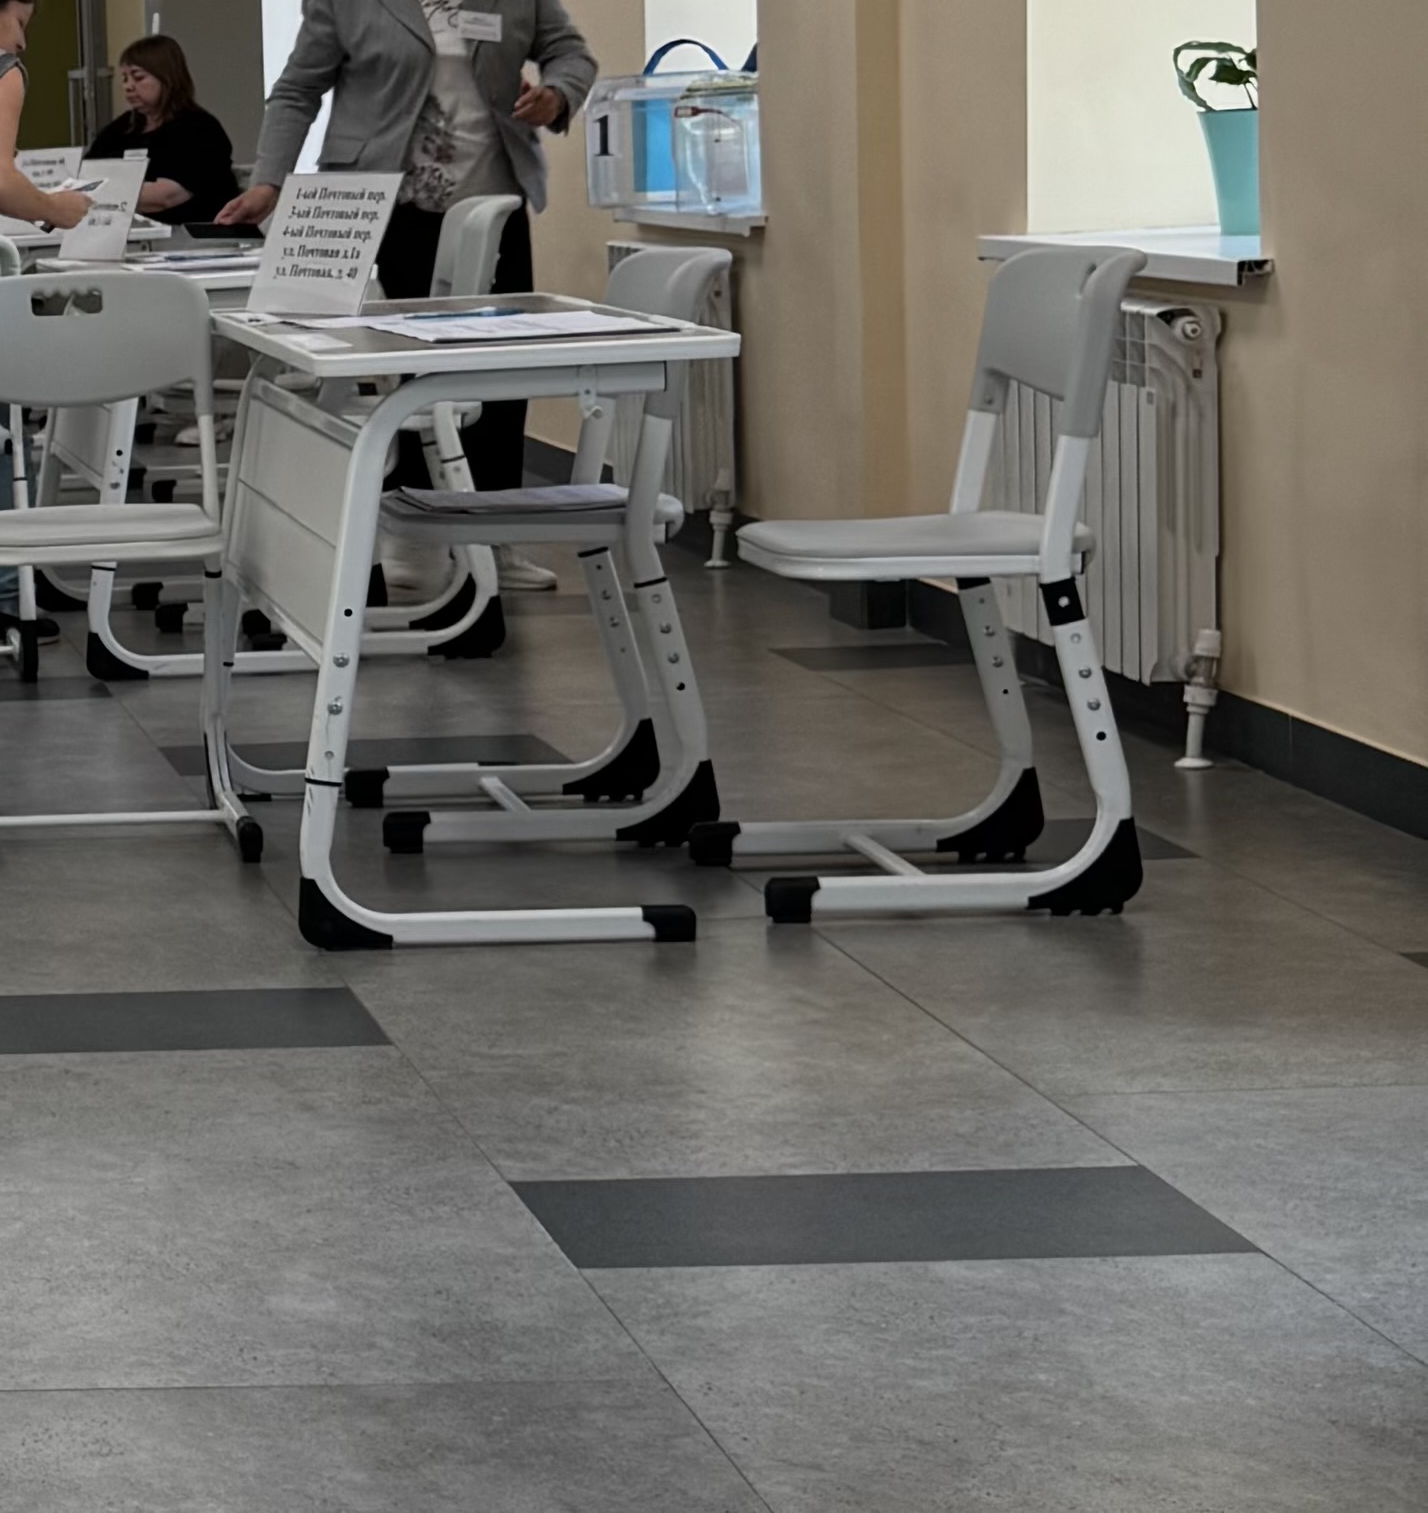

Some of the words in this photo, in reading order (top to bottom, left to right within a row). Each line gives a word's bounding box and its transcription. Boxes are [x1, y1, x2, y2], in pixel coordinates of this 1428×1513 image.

[592, 114, 615, 157] 1
[318, 187, 367, 201] Почтовый
[367, 190, 386, 204] пер.
[312, 206, 360, 220] Почтовый
[305, 225, 353, 239] Почтовый
[297, 244, 340, 258] Почтовая
